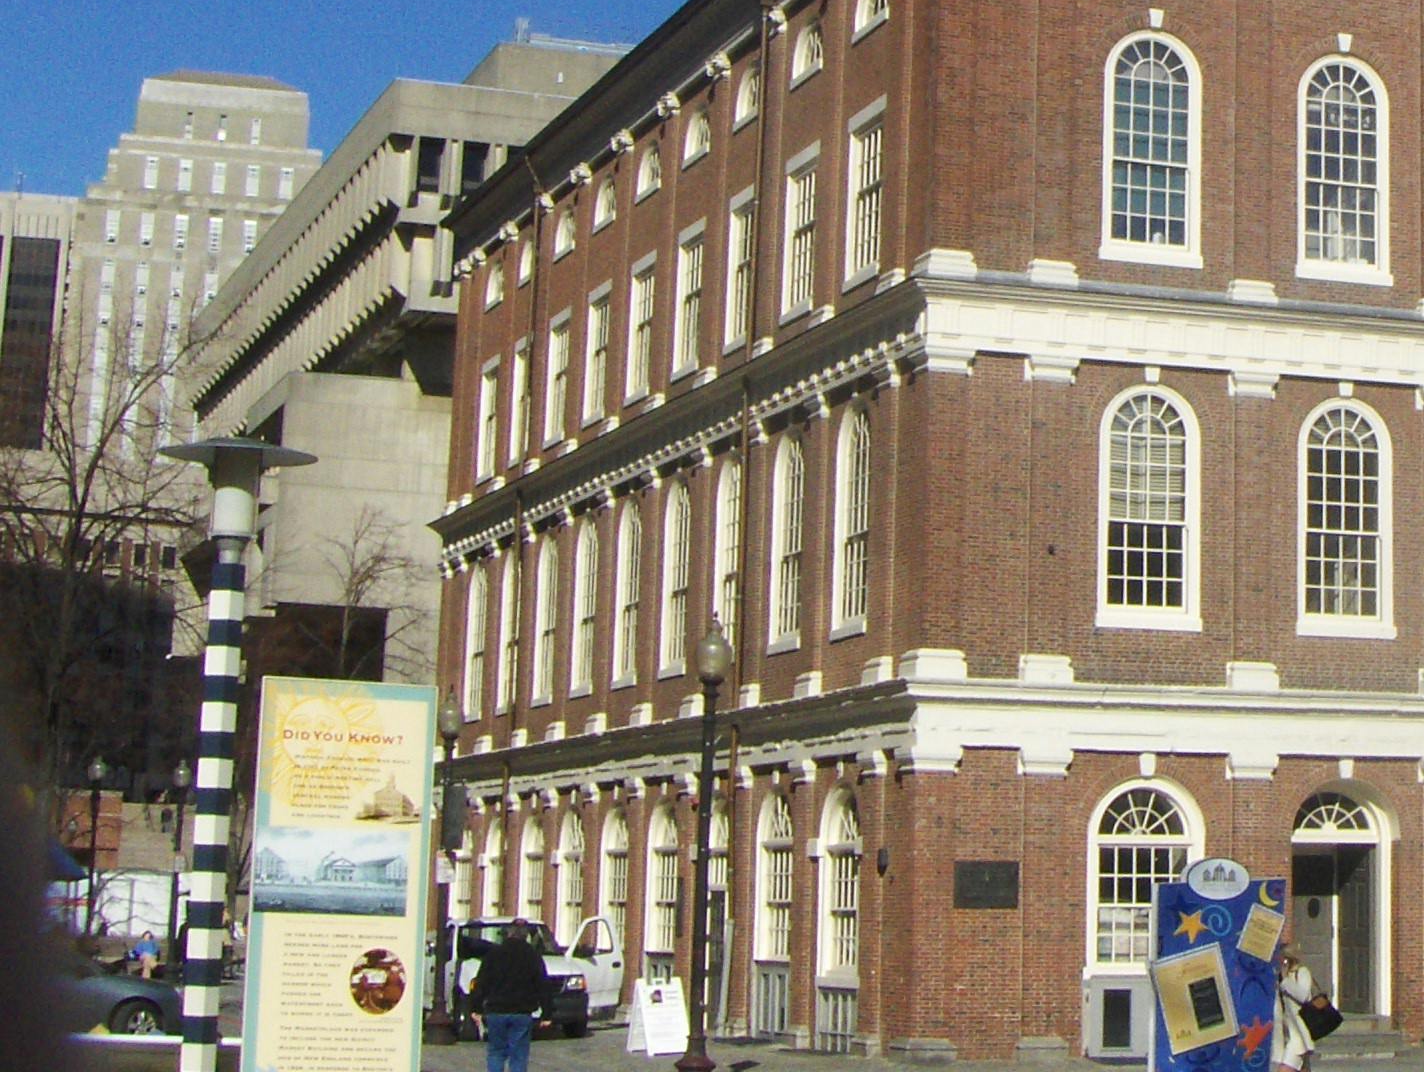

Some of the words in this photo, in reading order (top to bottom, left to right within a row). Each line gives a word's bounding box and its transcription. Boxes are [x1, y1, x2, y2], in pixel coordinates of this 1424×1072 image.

[283, 729, 310, 740] DID
[314, 731, 343, 742] YOU
[348, 733, 404, 744] KNOW?
